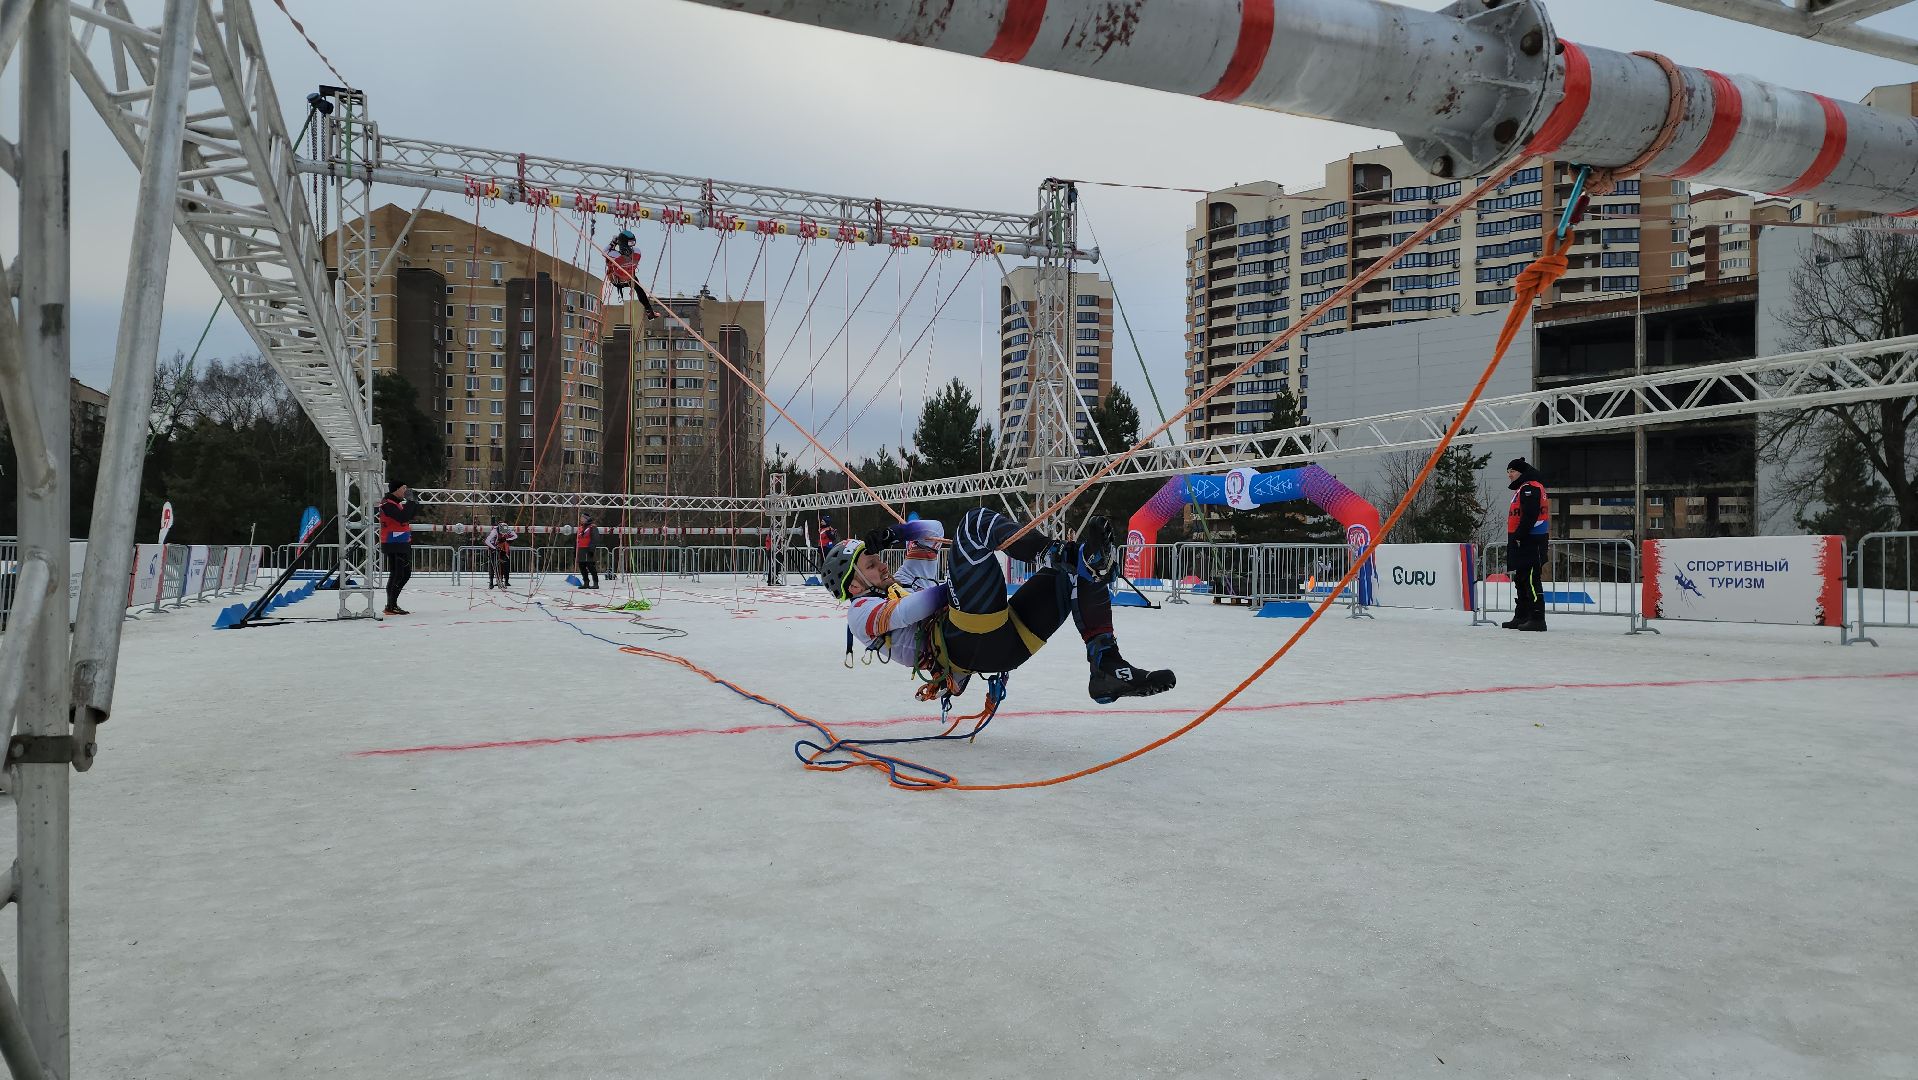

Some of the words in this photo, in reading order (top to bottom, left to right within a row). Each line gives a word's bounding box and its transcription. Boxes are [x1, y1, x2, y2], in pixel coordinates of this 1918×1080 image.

[549, 194, 560, 204] 11
[595, 204, 607, 213] 10
[641, 209, 649, 218] 9
[737, 221, 745, 230] 7
[777, 224, 786, 234] 6
[819, 227, 828, 236] 5
[857, 231, 865, 240] 4
[911, 236, 919, 246] 3
[956, 240, 964, 249] 2
[996, 244, 1003, 252] 1
[1686, 558, 1789, 572] СПОРТИВНЫЙ
[1392, 565, 1436, 587] GURU
[1708, 577, 1765, 589] ТУРИЗМ
